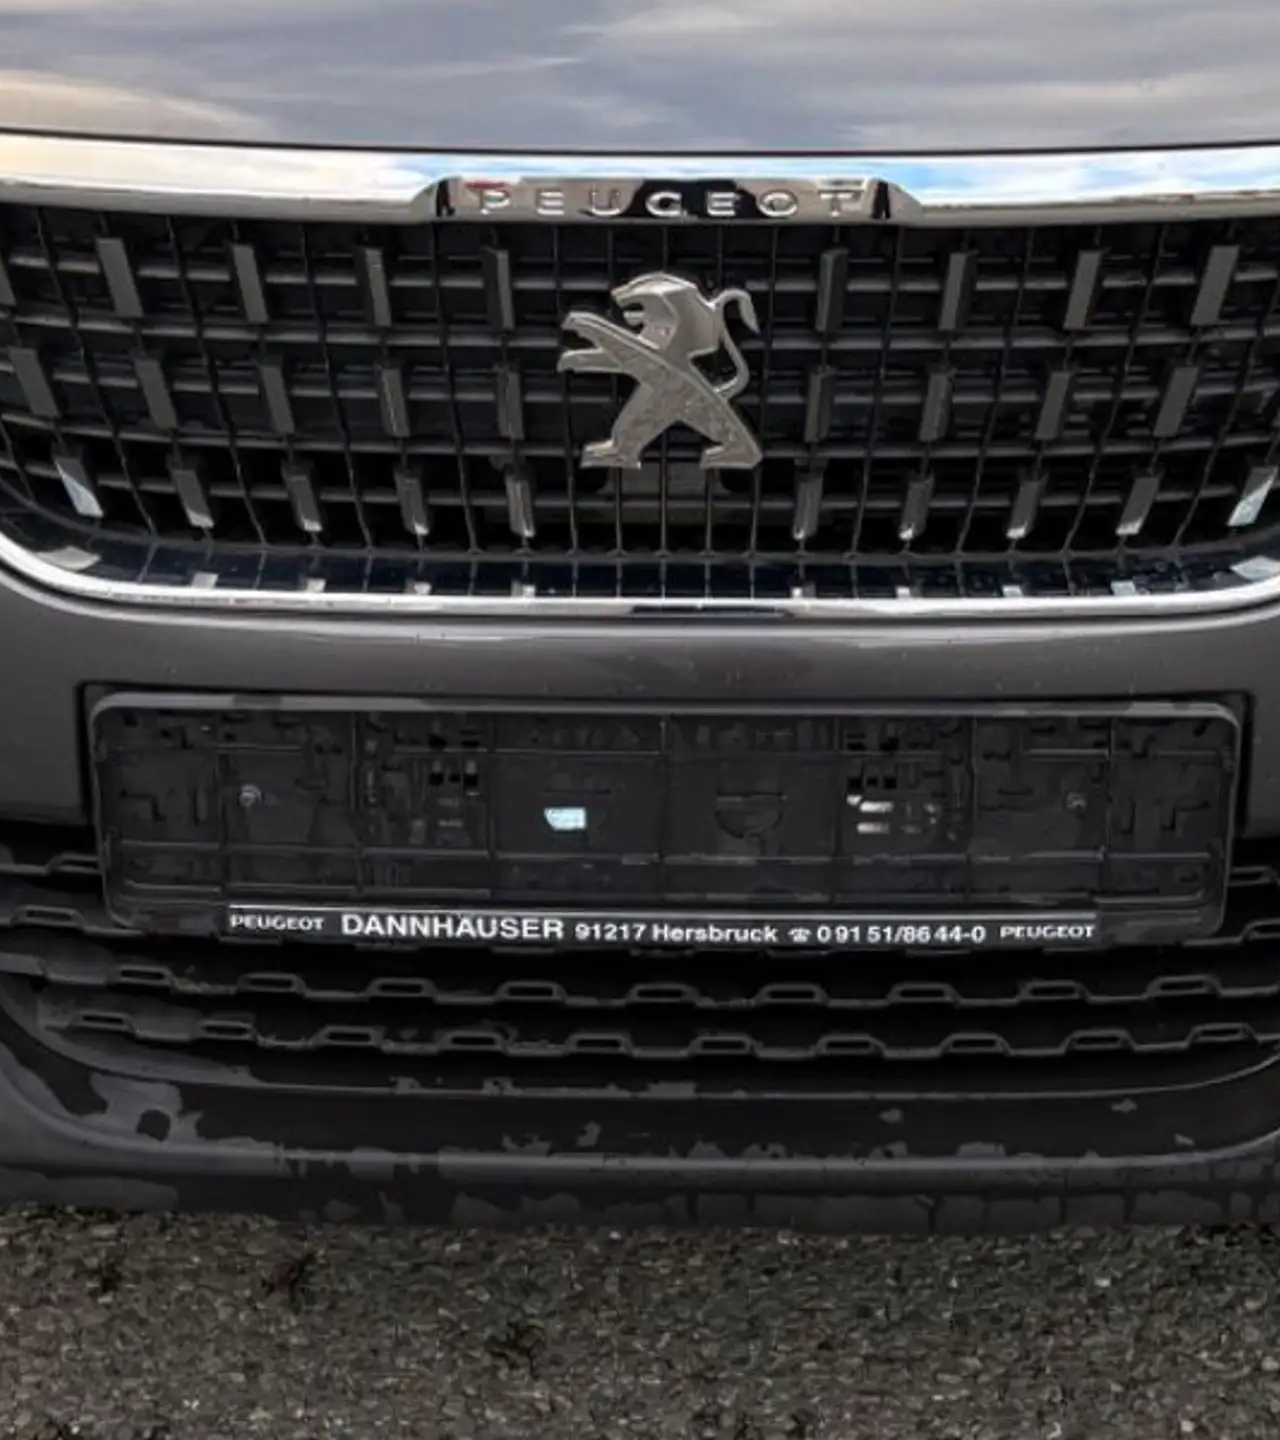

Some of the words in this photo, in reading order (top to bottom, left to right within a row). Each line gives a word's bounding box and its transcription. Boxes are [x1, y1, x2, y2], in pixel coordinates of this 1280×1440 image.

[476, 186, 864, 218] PEUGEOT
[229, 914, 324, 931] PEUGEOT
[574, 923, 646, 942] 91217
[652, 923, 778, 943] Hersbruck
[1000, 924, 1096, 939] PEUGEOT
